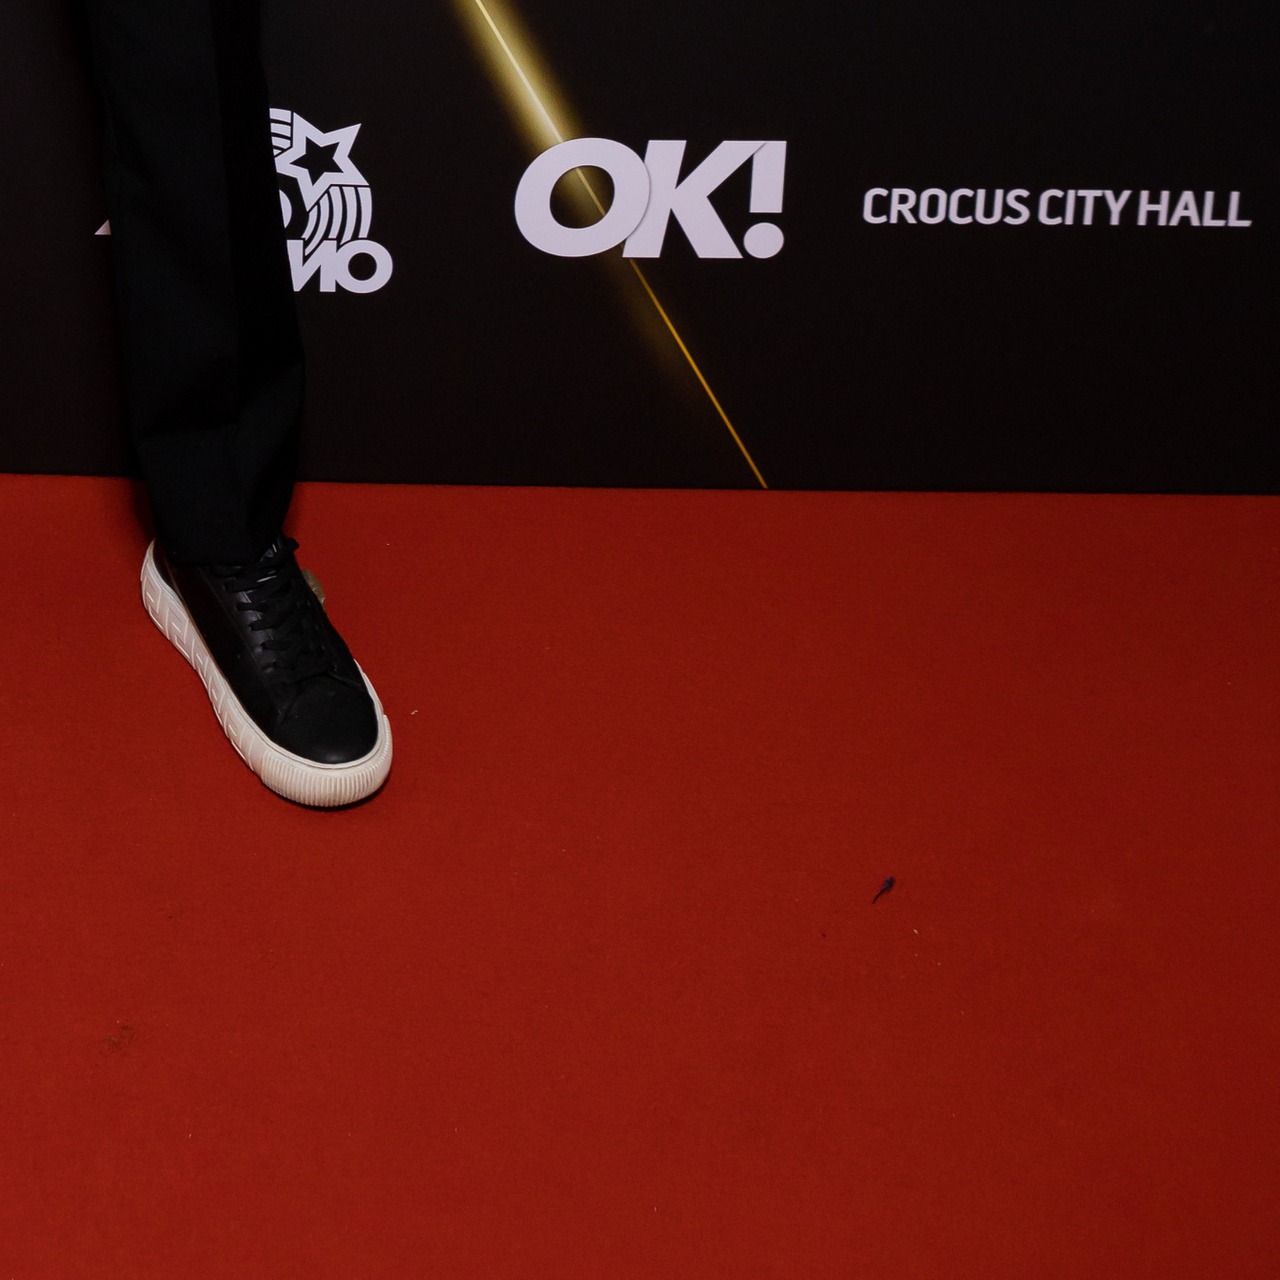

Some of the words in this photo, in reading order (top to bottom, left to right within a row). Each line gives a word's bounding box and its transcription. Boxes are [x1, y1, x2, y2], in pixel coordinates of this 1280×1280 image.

[515, 137, 787, 258] OK!
[863, 188, 1030, 225] CROCUS
[1039, 189, 1131, 226] CITY
[1137, 191, 1252, 227] HALL
